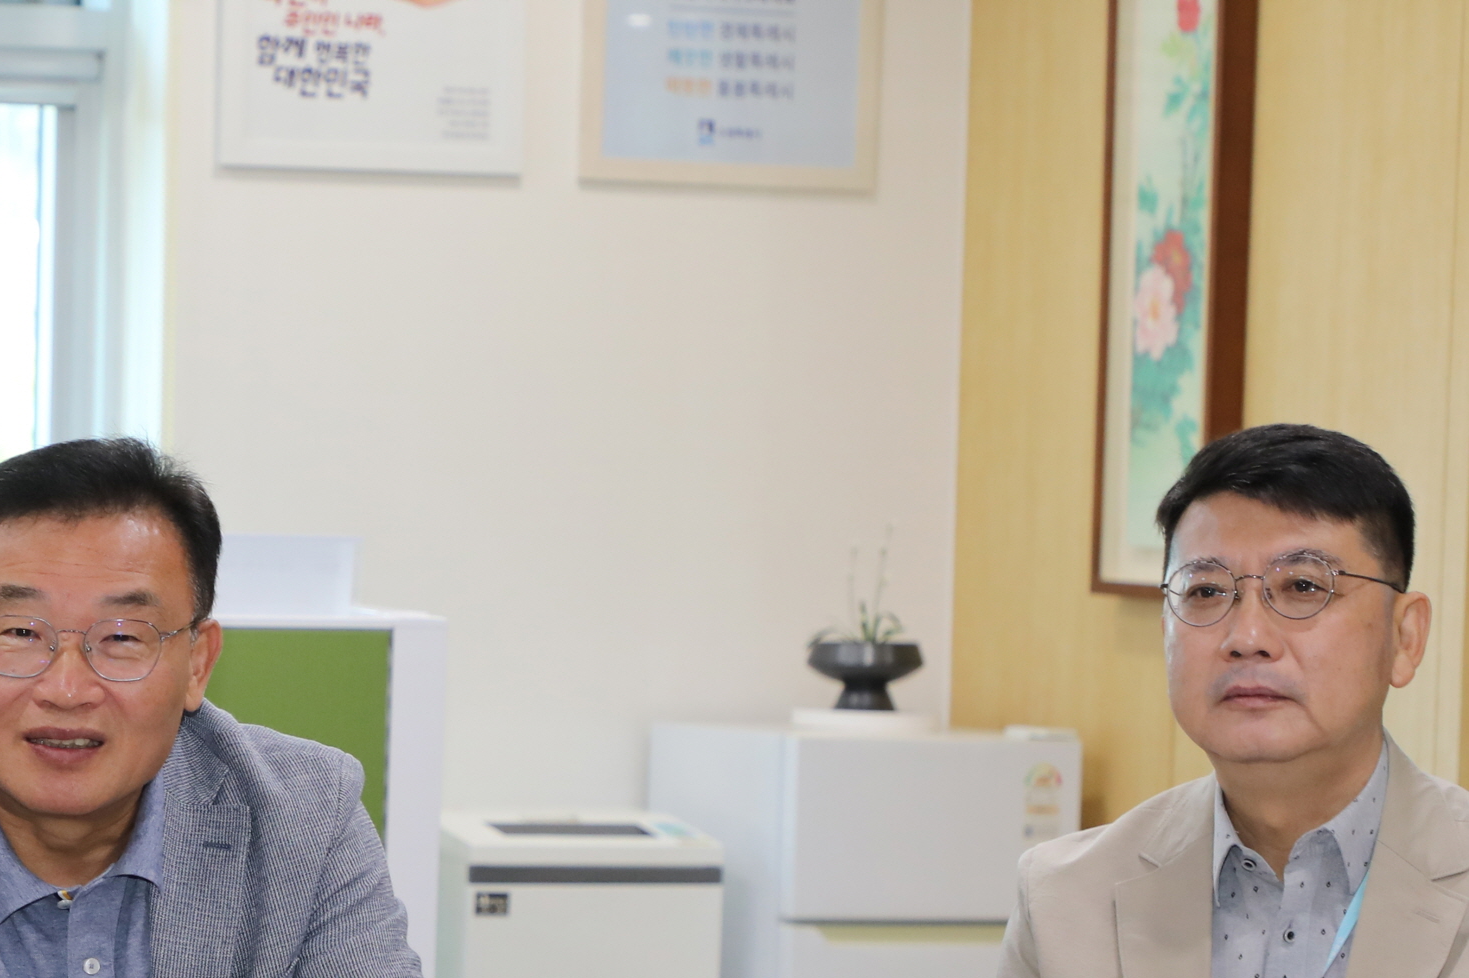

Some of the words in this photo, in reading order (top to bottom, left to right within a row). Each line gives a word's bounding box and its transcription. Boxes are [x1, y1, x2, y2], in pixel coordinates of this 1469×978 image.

[257, 34, 308, 65] 함께
[315, 39, 372, 66] 행복한
[273, 65, 371, 99] 대한민국
